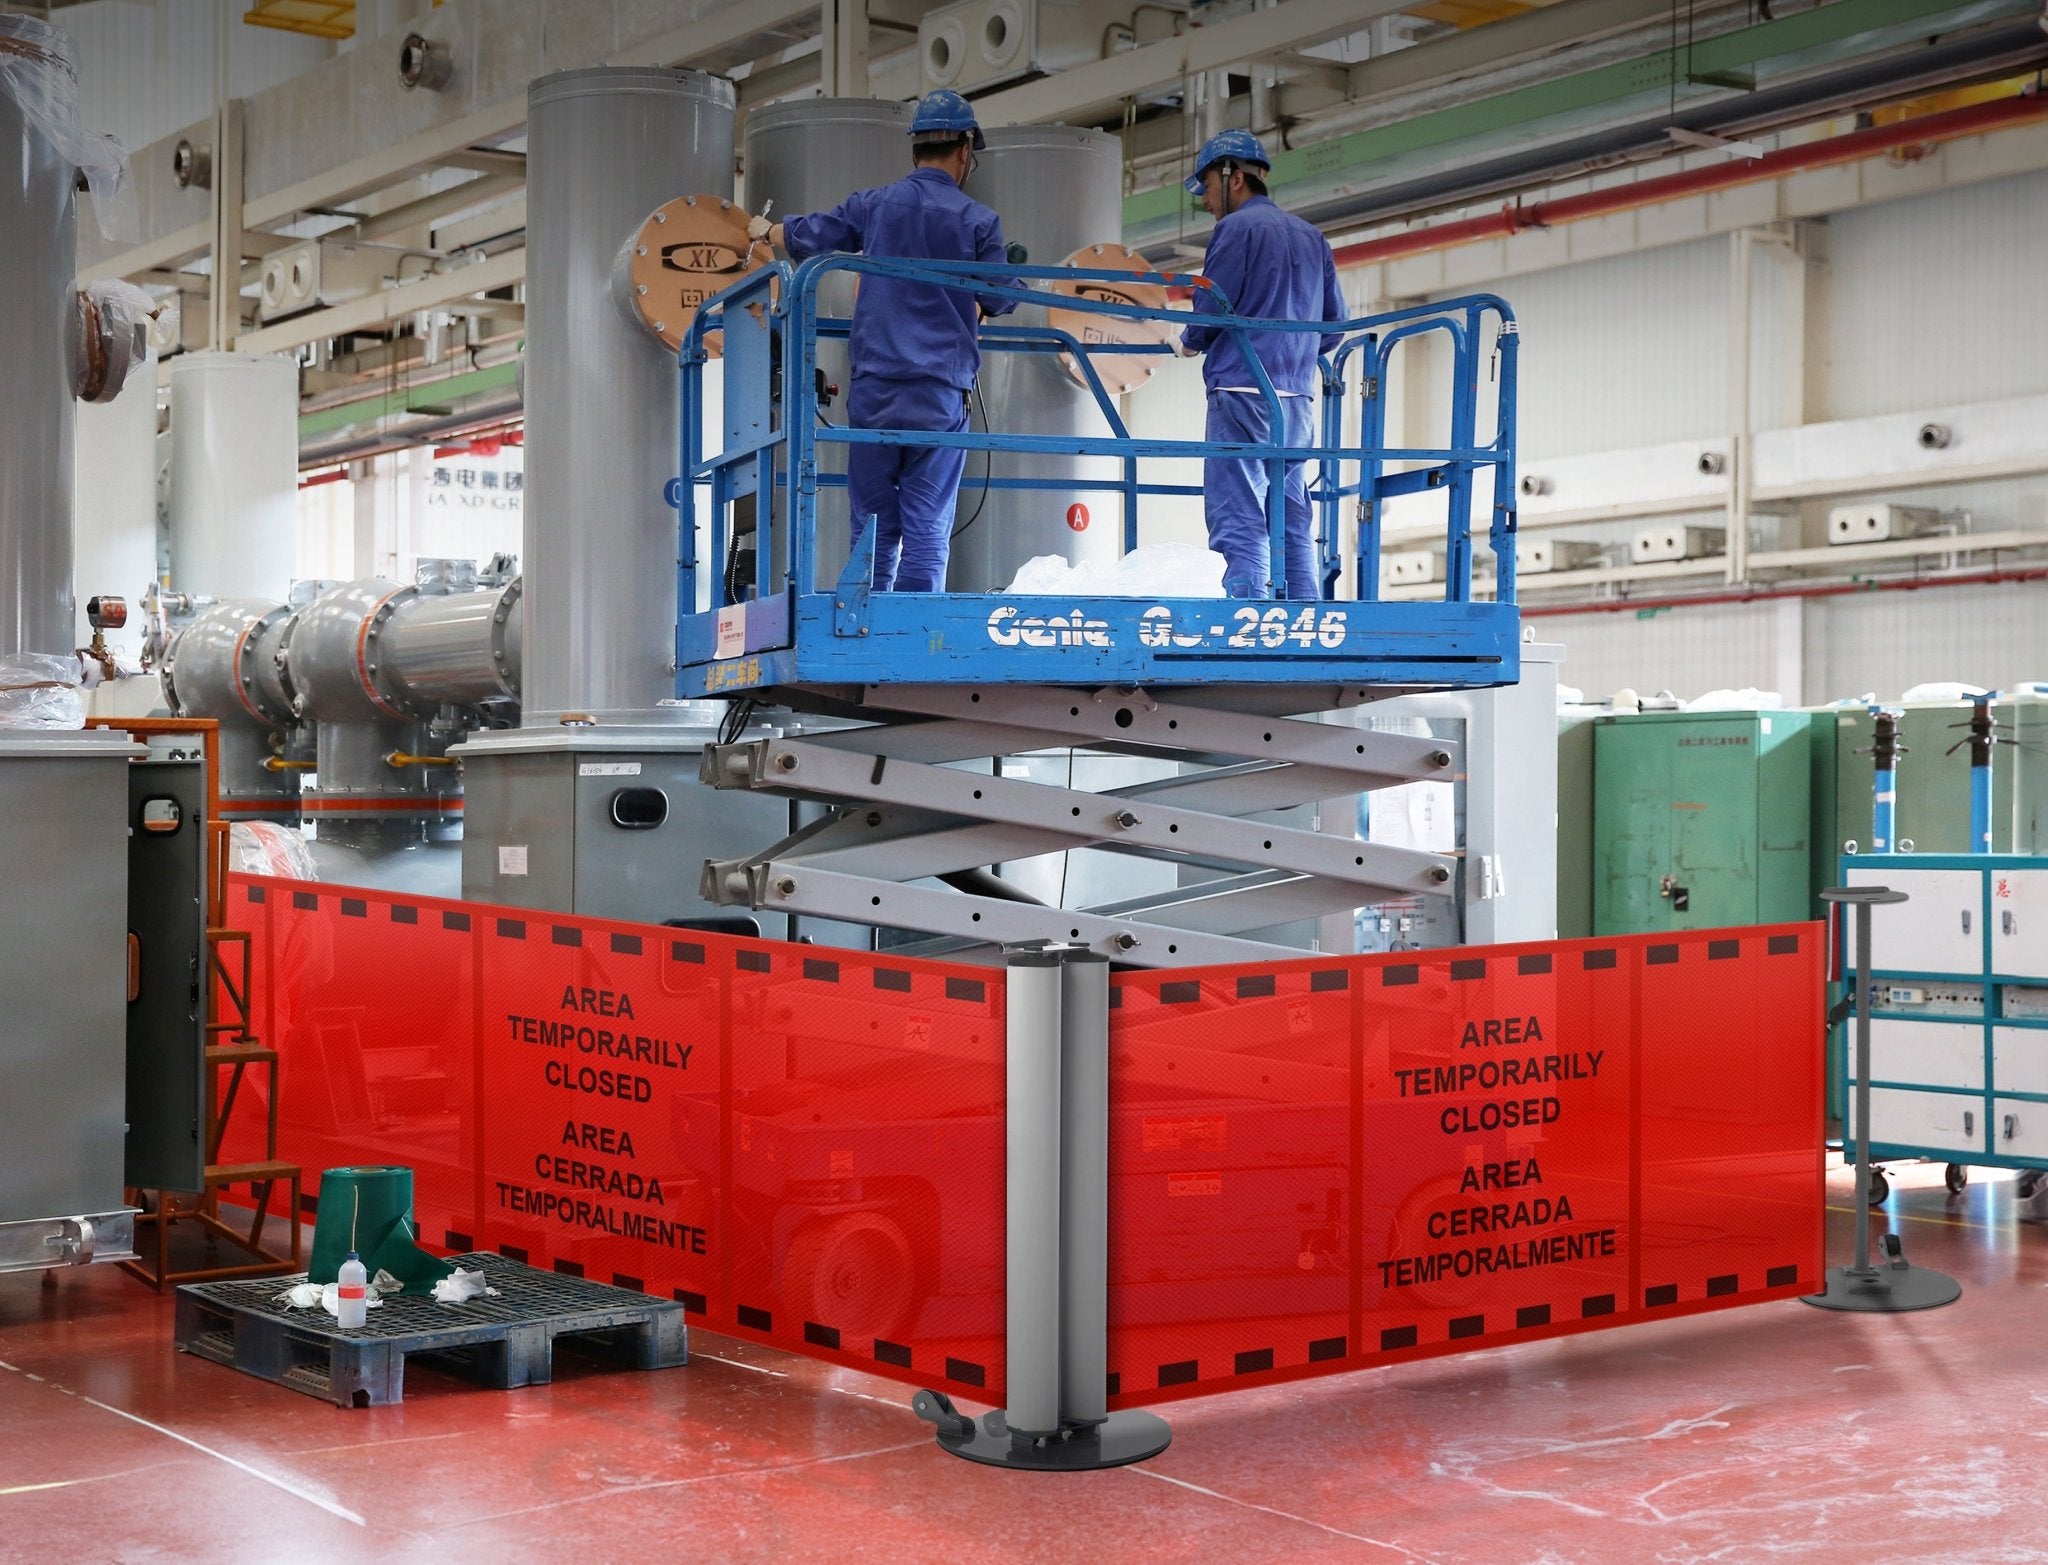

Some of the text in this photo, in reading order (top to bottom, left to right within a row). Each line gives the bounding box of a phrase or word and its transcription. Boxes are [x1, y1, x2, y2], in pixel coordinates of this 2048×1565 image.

[689, 249, 719, 268] XK
[1073, 508, 1085, 528] A
[987, 606, 1110, 648] Genie
[561, 985, 634, 1020] AREA
[507, 1014, 693, 1069] TEMPORARILY
[1460, 1016, 1543, 1049] AREA
[545, 1060, 652, 1103] CLOSED
[1394, 1051, 1604, 1098] TEMPORARILY
[1440, 1096, 1561, 1135] CLOSED
[562, 1120, 635, 1159] AREA
[535, 1153, 665, 1206] CERRADA
[1459, 1158, 1542, 1193] AREA
[496, 1181, 707, 1255] TEMPORALMENTE
[1427, 1195, 1573, 1239] CERRADA
[1378, 1229, 1616, 1288] TEMPORALMENTE
